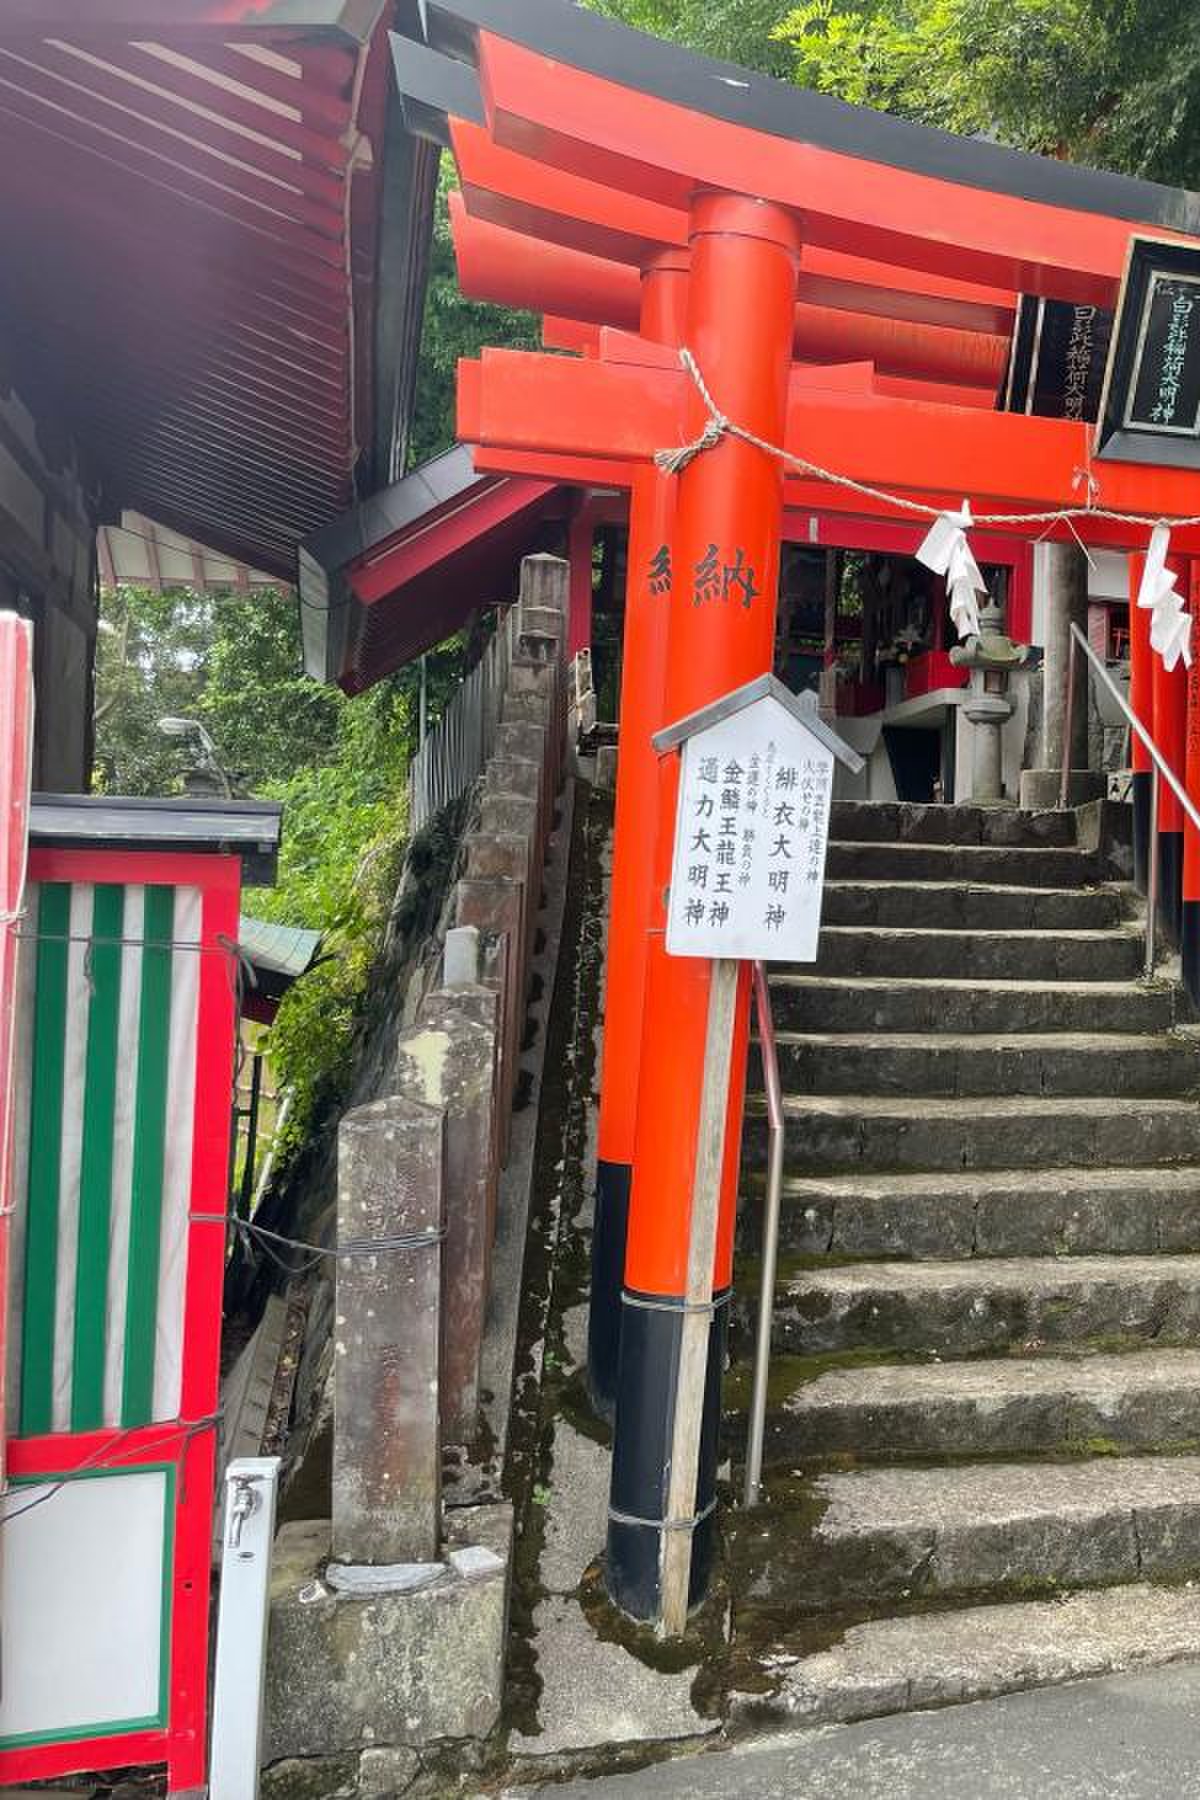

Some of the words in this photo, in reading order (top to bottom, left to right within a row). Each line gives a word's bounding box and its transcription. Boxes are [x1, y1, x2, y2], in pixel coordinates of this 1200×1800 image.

[692, 543, 761, 609] 納
[765, 767, 799, 932] 緋衣大明神
